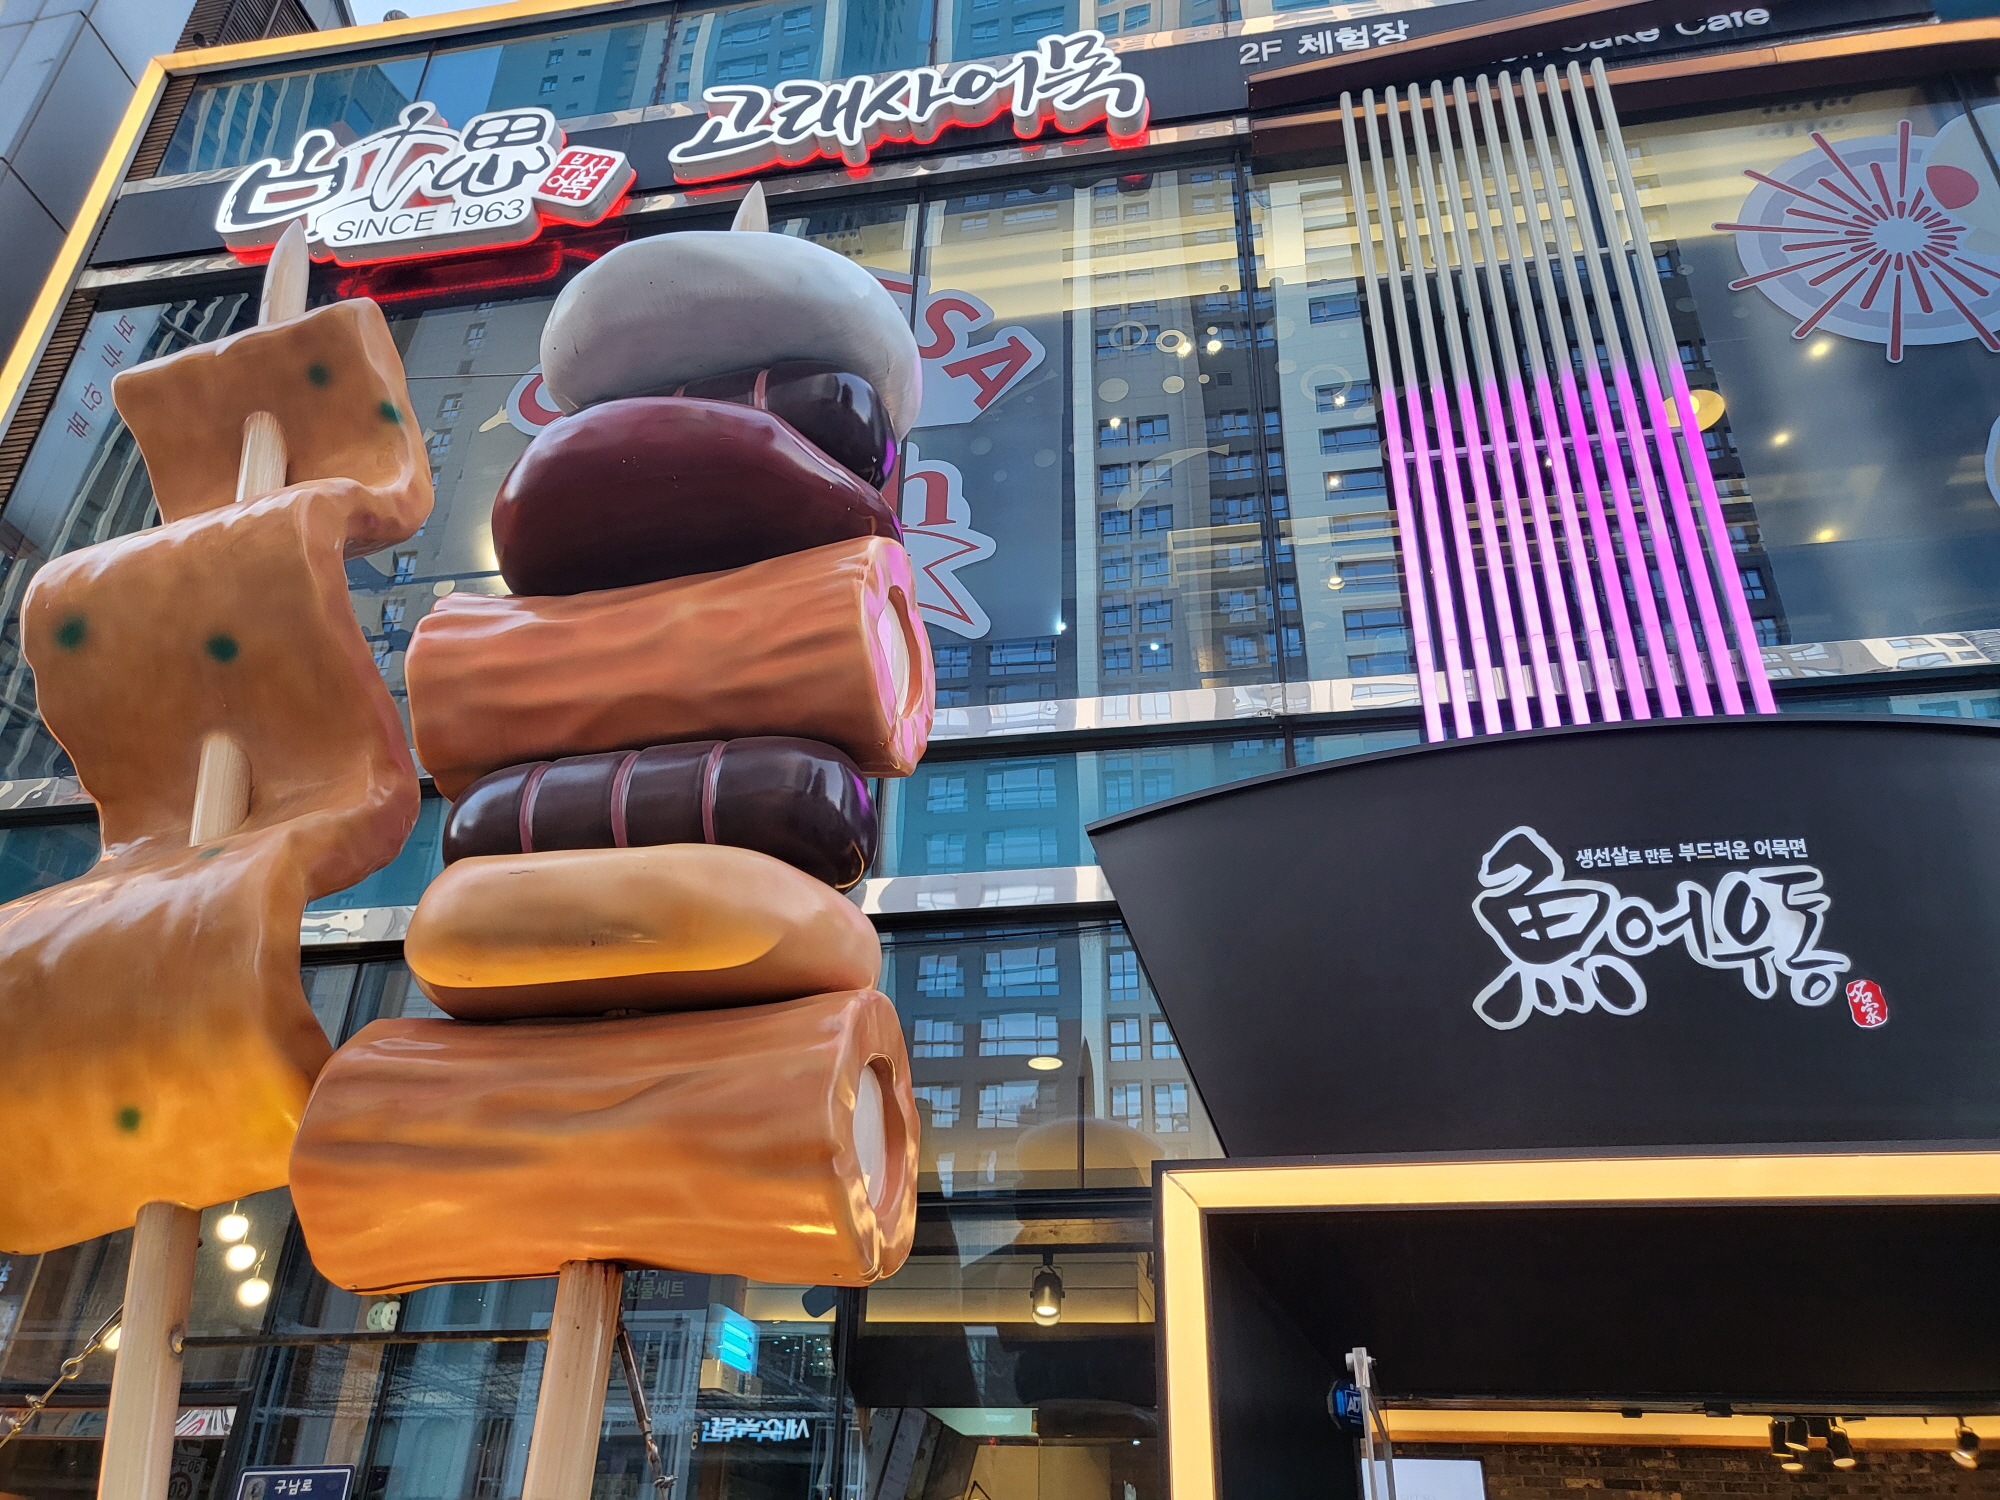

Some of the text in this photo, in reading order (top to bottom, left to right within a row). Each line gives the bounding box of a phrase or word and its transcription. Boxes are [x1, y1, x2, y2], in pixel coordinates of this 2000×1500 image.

[1239, 19, 1409, 66] 2F 체험장
[674, 32, 1142, 160] 고래사어묵
[332, 199, 525, 243] SINCE 1963
[1575, 837, 1809, 870] 생선살로 만든 부드러운 어묵면
[625, 1280, 685, 1300] 선물세트
[273, 1478, 314, 1496] 구남로
